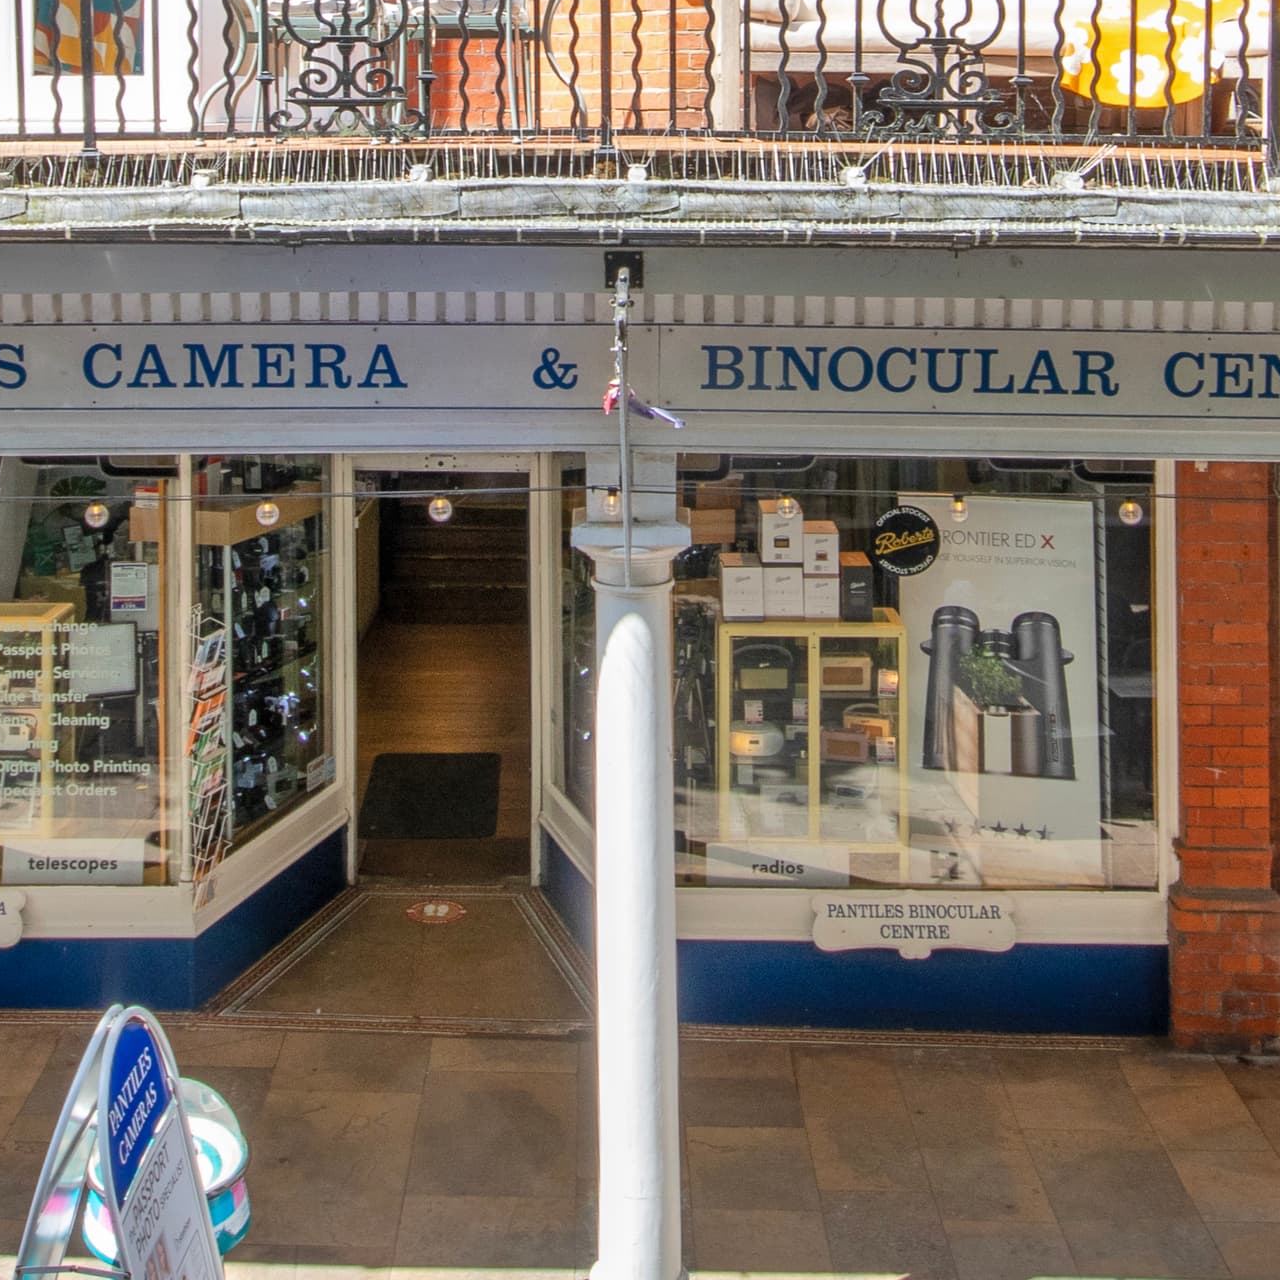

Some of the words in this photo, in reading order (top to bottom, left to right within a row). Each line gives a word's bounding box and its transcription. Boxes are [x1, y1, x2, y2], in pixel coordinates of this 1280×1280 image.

[83, 343, 408, 389] CAMERA
[532, 347, 578, 390] &
[701, 344, 1119, 397] BINOCULAR
[876, 508, 900, 527] OFFICIAL
[901, 507, 930, 524] STOCKIST
[875, 527, 935, 555] Roberts
[940, 529, 1010, 548] RONTIER
[1015, 533, 1037, 549] ED
[1040, 534, 1055, 550] X
[908, 554, 934, 573] OFFICIAL
[952, 553, 992, 563] YOURSELF
[994, 555, 1004, 564] IN
[1005, 555, 1045, 567] SUPERIOR
[27, 620, 98, 635] Exchange
[61, 643, 111, 656] Photos
[53, 666, 121, 682] Servicing
[31, 690, 89, 702] Trnsfer
[48, 713, 110, 729] Cleaning
[48, 760, 89, 773] Photo
[94, 760, 151, 776] Printing
[66, 784, 117, 797] Orders
[28, 857, 119, 874] telescopes
[752, 860, 804, 875] radios
[827, 903, 904, 919] PANTILES
[909, 904, 1001, 920] BINOCULAR
[879, 924, 950, 939] CENTRE
[108, 1046, 152, 1137] PANTILES
[119, 1082, 157, 1165] CAMERAS
[133, 1141, 169, 1226] PASSPORT
[135, 1198, 160, 1261] PHOTO
